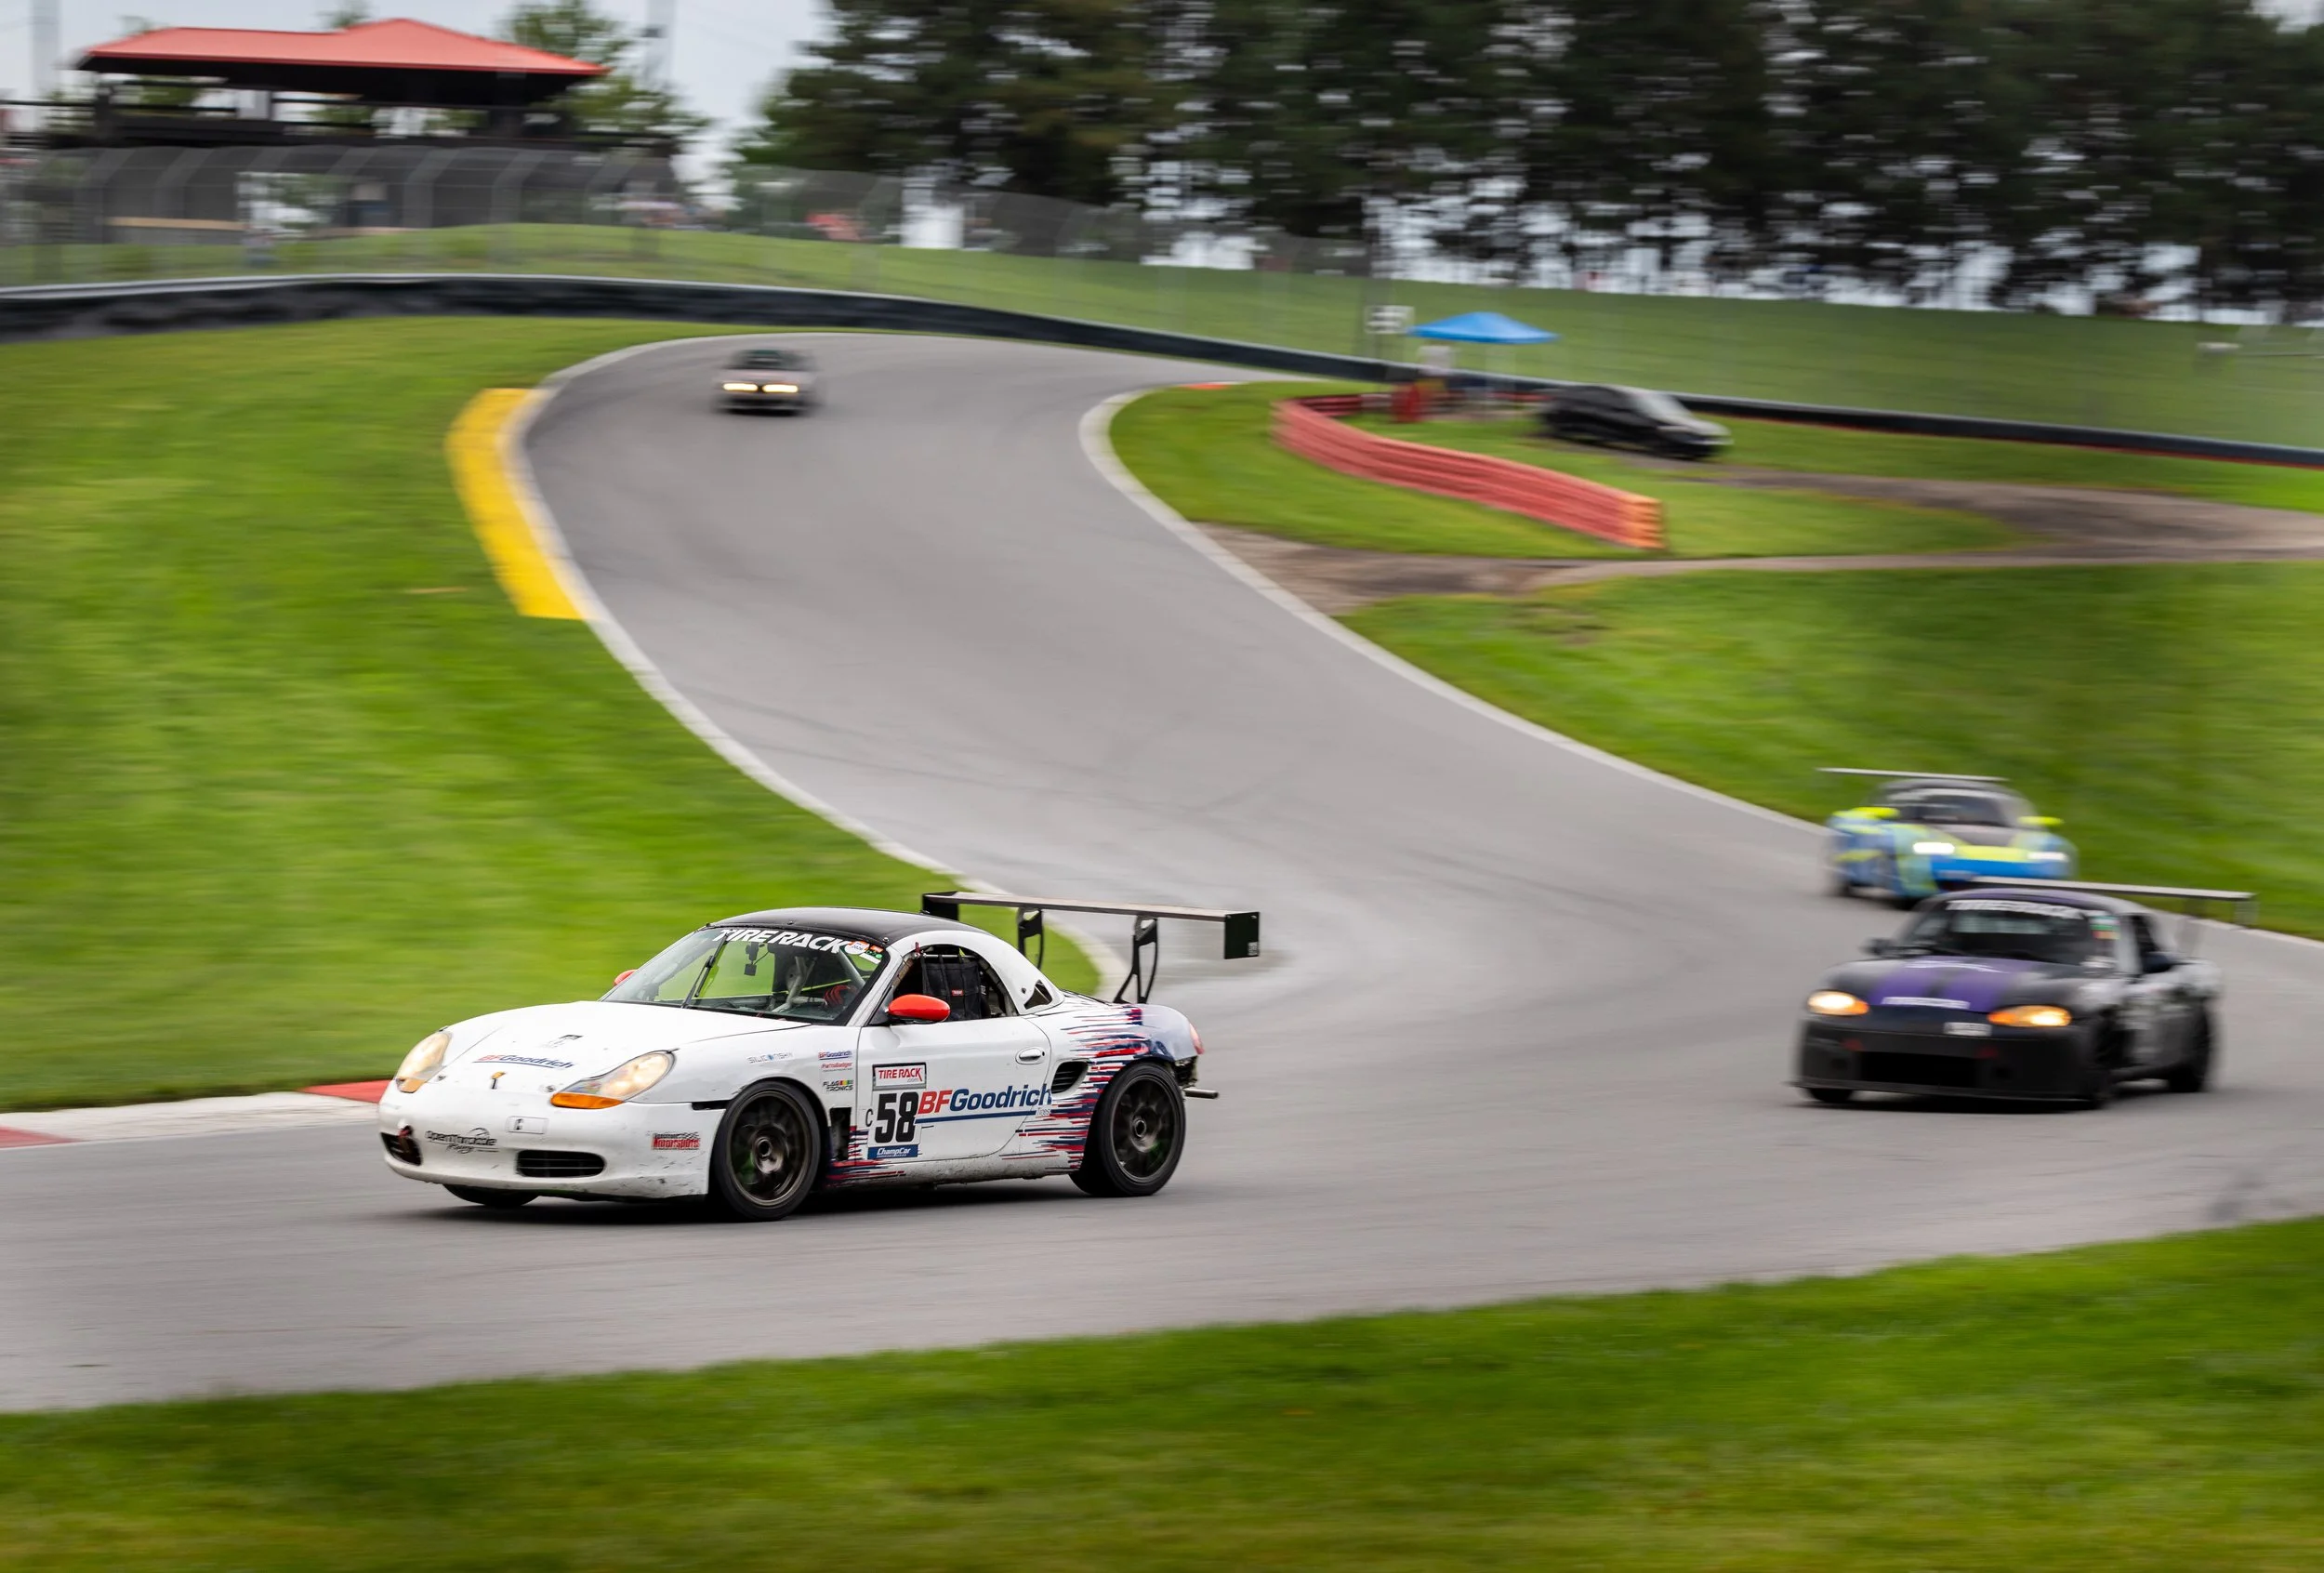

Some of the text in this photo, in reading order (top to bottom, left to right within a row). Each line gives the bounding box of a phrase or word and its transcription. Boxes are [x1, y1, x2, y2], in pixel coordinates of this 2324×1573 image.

[712, 929, 852, 954] TIRE RACK
[478, 1054, 575, 1069] BFGoodrich
[818, 1051, 853, 1059] BFGoodrich
[878, 1067, 923, 1082] TIRE RACK
[918, 1083, 1052, 1115] BFGoodrich
[865, 1108, 874, 1128] C
[874, 1091, 919, 1143] 58
[877, 1147, 912, 1158] ChampCar
